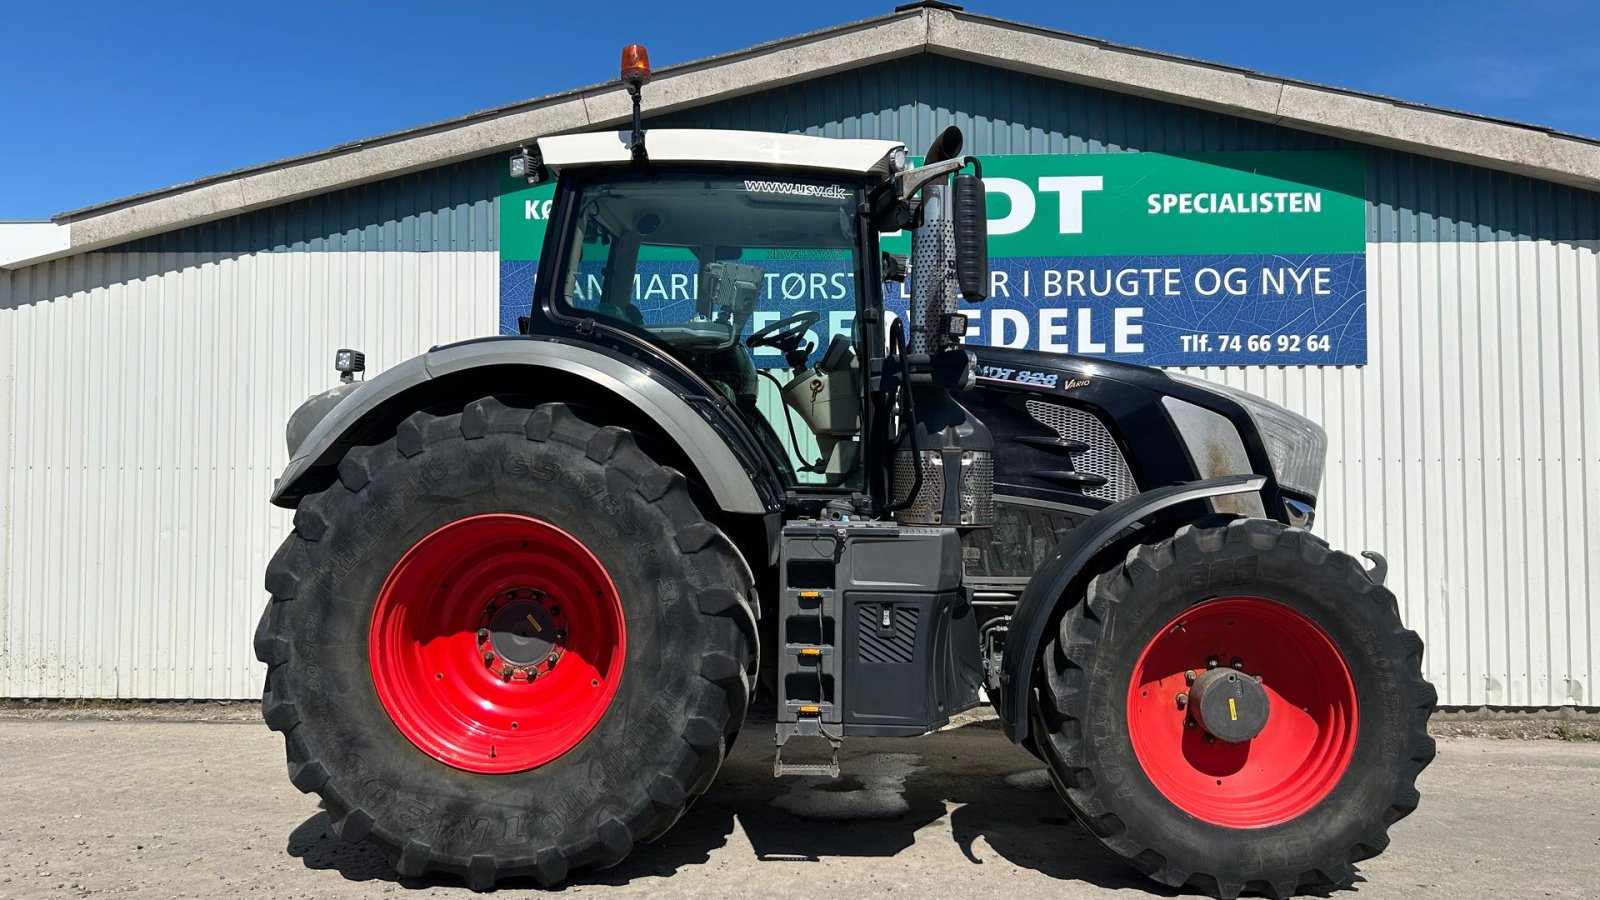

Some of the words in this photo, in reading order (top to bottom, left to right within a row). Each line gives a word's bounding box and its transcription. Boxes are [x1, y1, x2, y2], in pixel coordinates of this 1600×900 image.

[744, 180, 845, 199] www.usv.dk
[525, 199, 553, 220] KØ
[1147, 192, 1322, 214] SPECIALISTEN
[1023, 270, 1029, 297] I
[1044, 268, 1181, 297] BRUGTE
[1194, 267, 1247, 296] OG
[1262, 267, 1331, 295] NYE
[1180, 334, 1212, 352] Tlf.
[1218, 335, 1241, 352] 74
[1247, 335, 1271, 352] 66
[1277, 335, 1300, 352] 92
[1306, 334, 1330, 352] 64
[1015, 370, 1058, 386] 828
